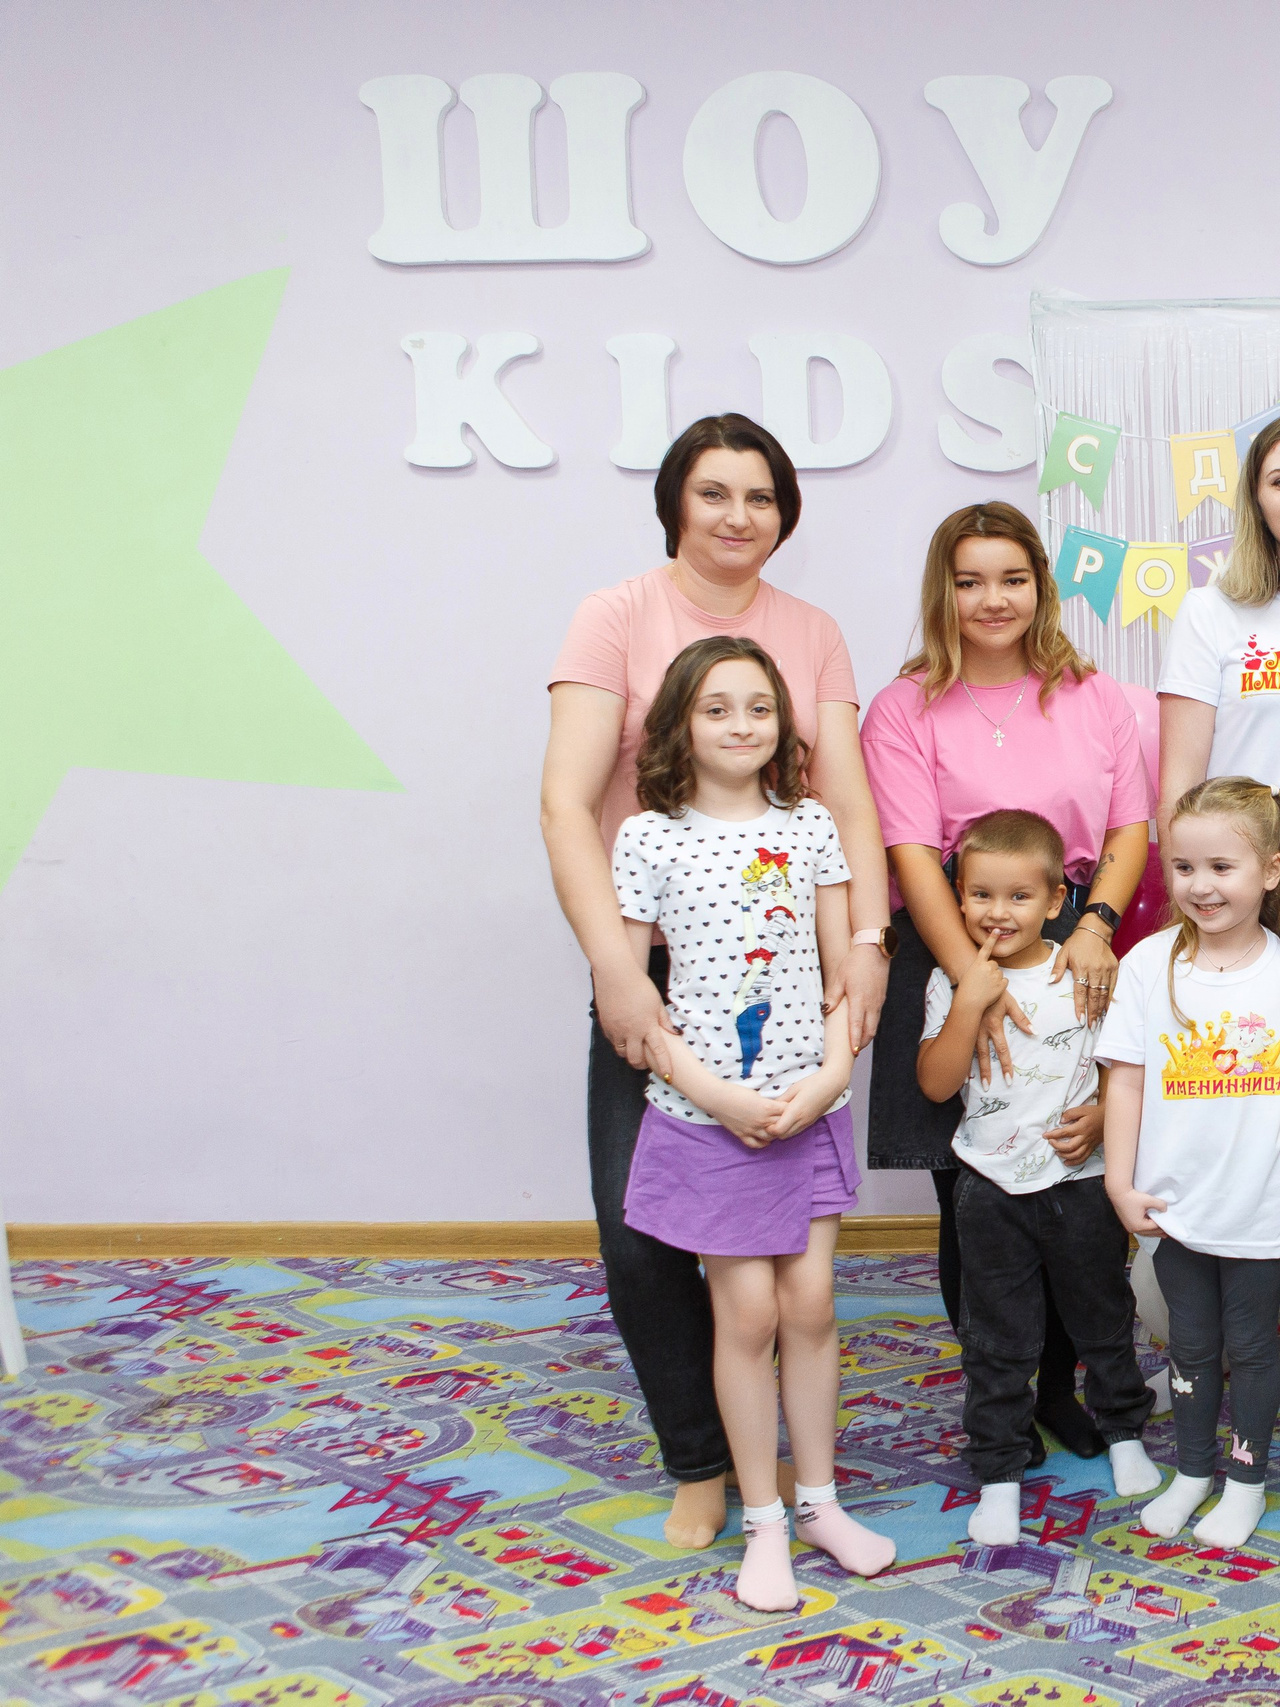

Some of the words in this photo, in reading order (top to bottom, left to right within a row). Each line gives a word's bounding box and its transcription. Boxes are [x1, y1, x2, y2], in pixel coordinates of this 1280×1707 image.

[358, 70, 1113, 266] ШОУ
[401, 332, 1037, 471] KIDS
[1067, 435, 1100, 475] С
